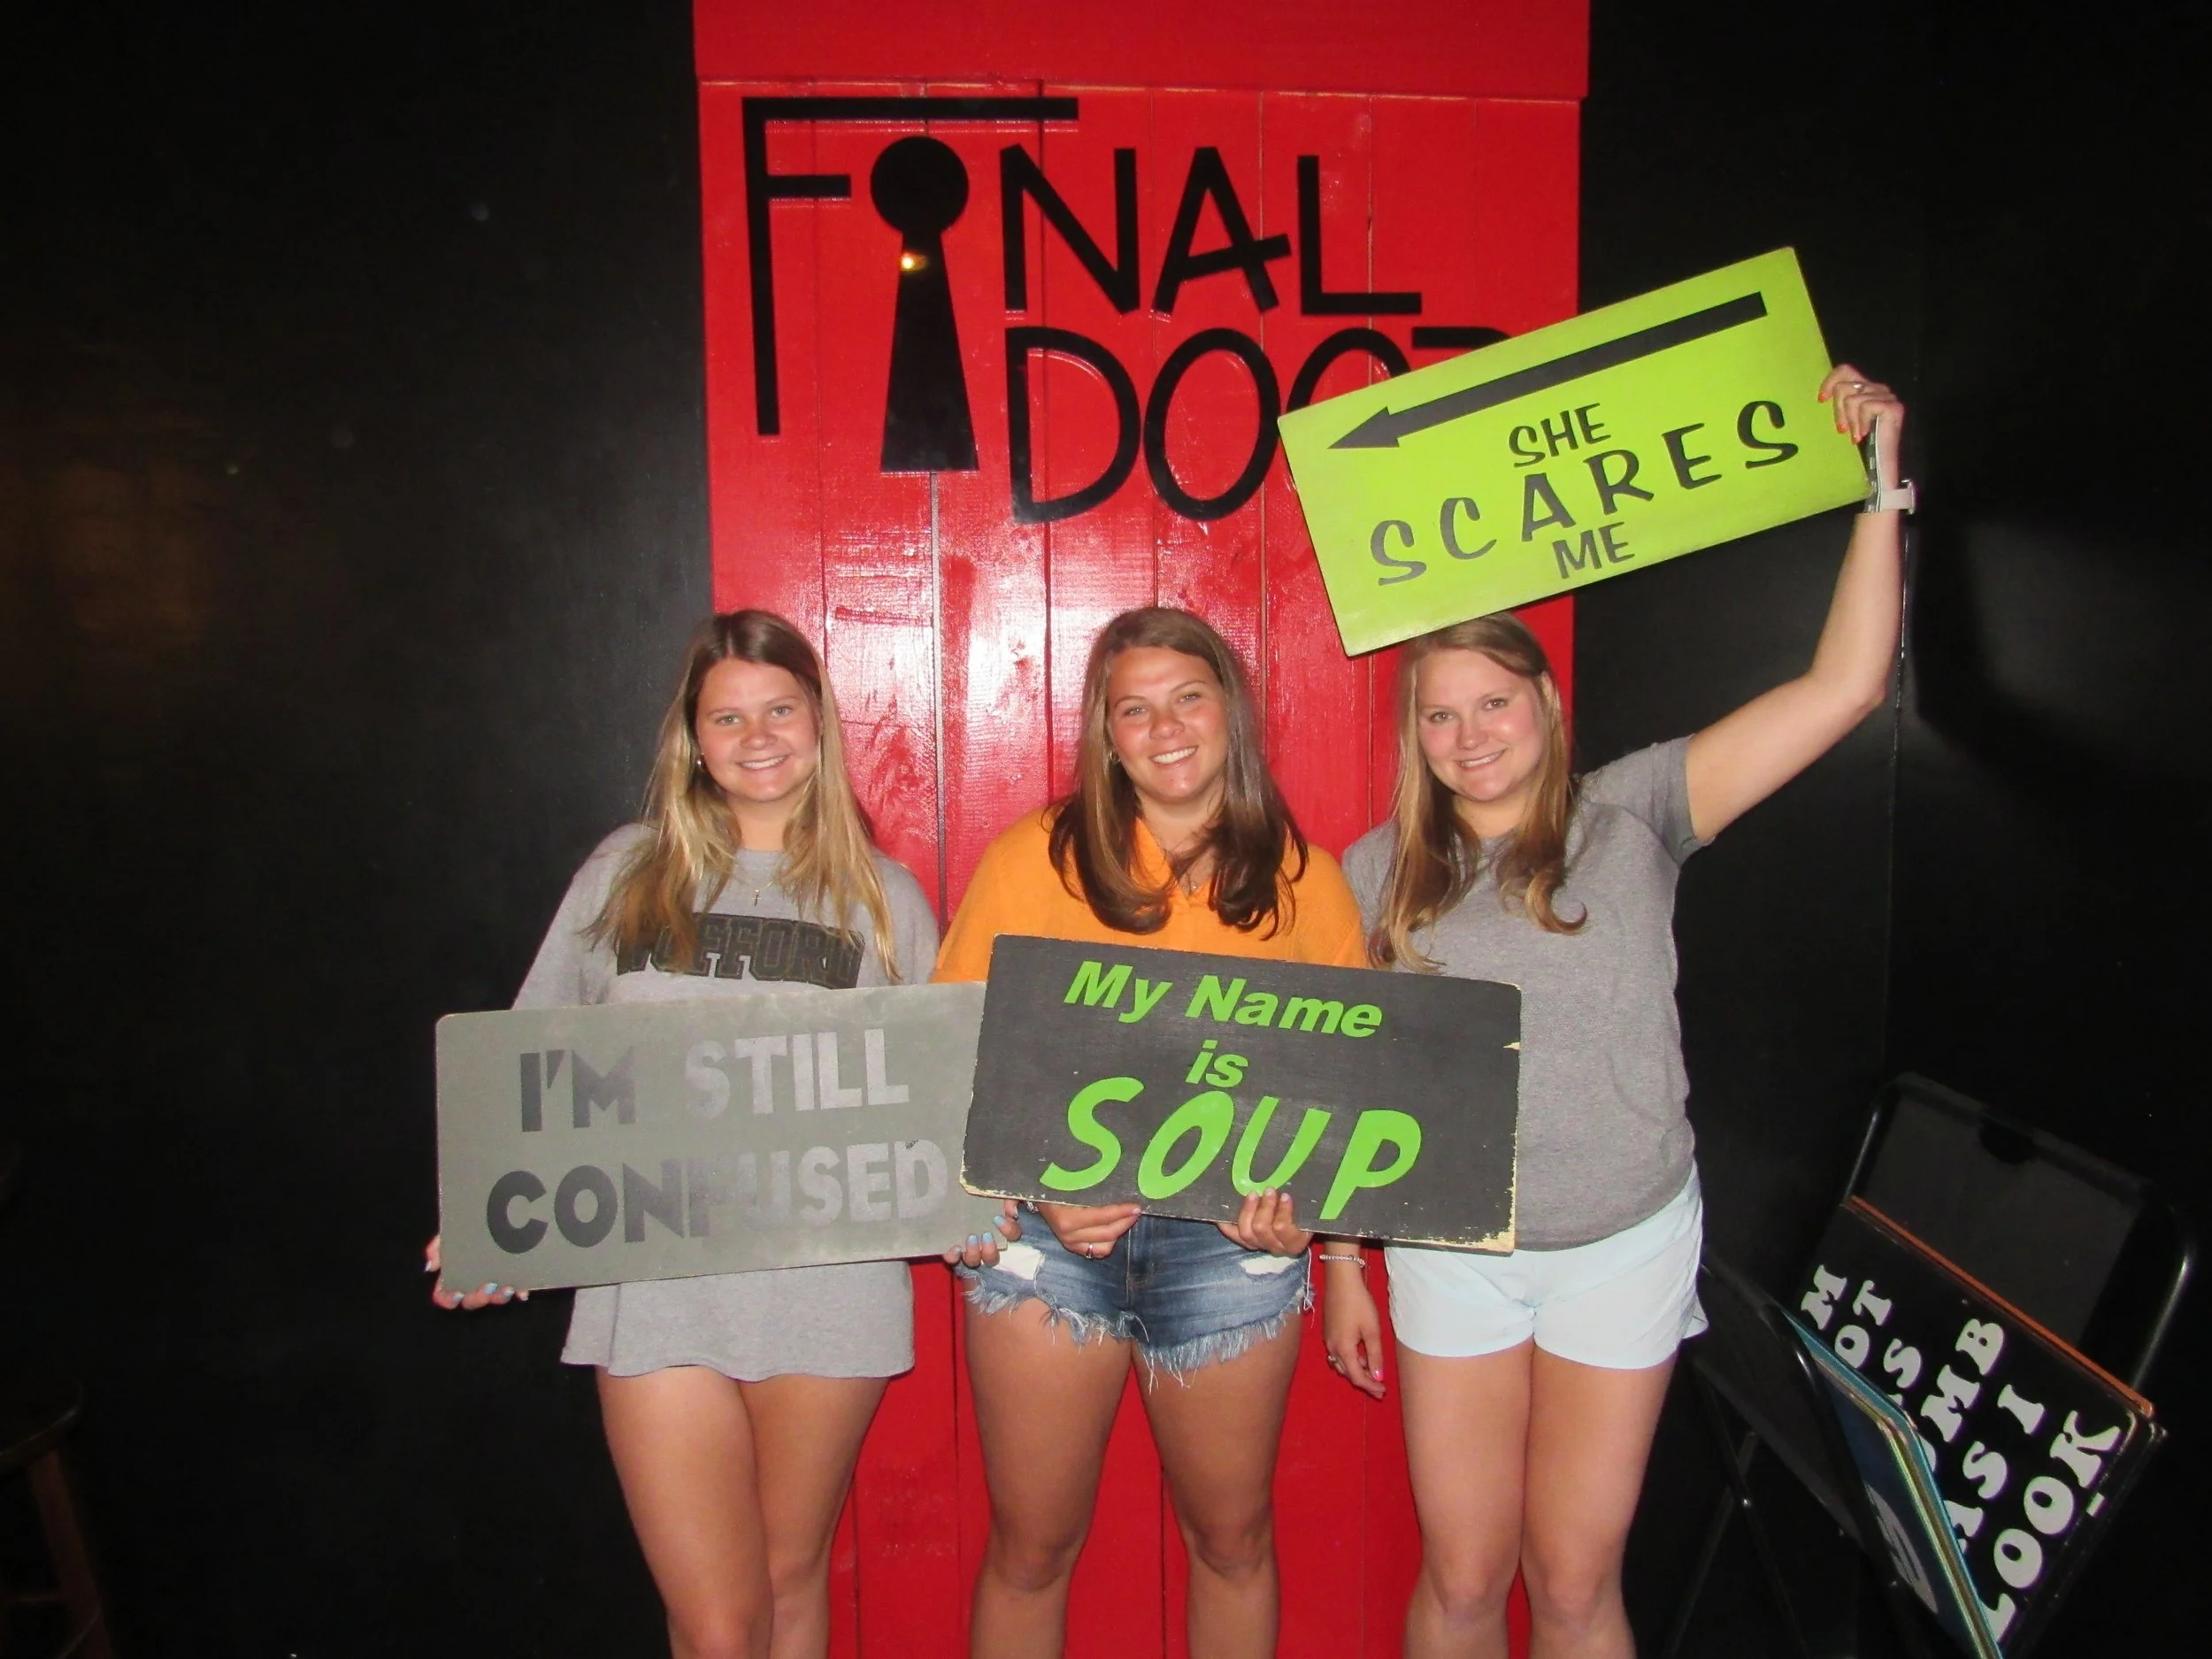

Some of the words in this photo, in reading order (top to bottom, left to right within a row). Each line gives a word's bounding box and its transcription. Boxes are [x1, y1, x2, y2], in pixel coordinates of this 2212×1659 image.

[1004, 326, 1513, 526] DO
[1509, 403, 1612, 468] SHE
[1371, 400, 1799, 587] SCARES
[1553, 522, 1635, 579] ME
[1064, 961, 1173, 1024] My
[1185, 975, 1383, 1038] Name
[519, 1048, 636, 1133] I'M
[684, 1028, 910, 1121] STILL
[1185, 1040, 1248, 1088] is
[1040, 1077, 1422, 1219] SOUP
[487, 1140, 949, 1254] CONFUSED
[1834, 1279, 1893, 1369] OT
[1997, 1383, 2046, 1435] I
